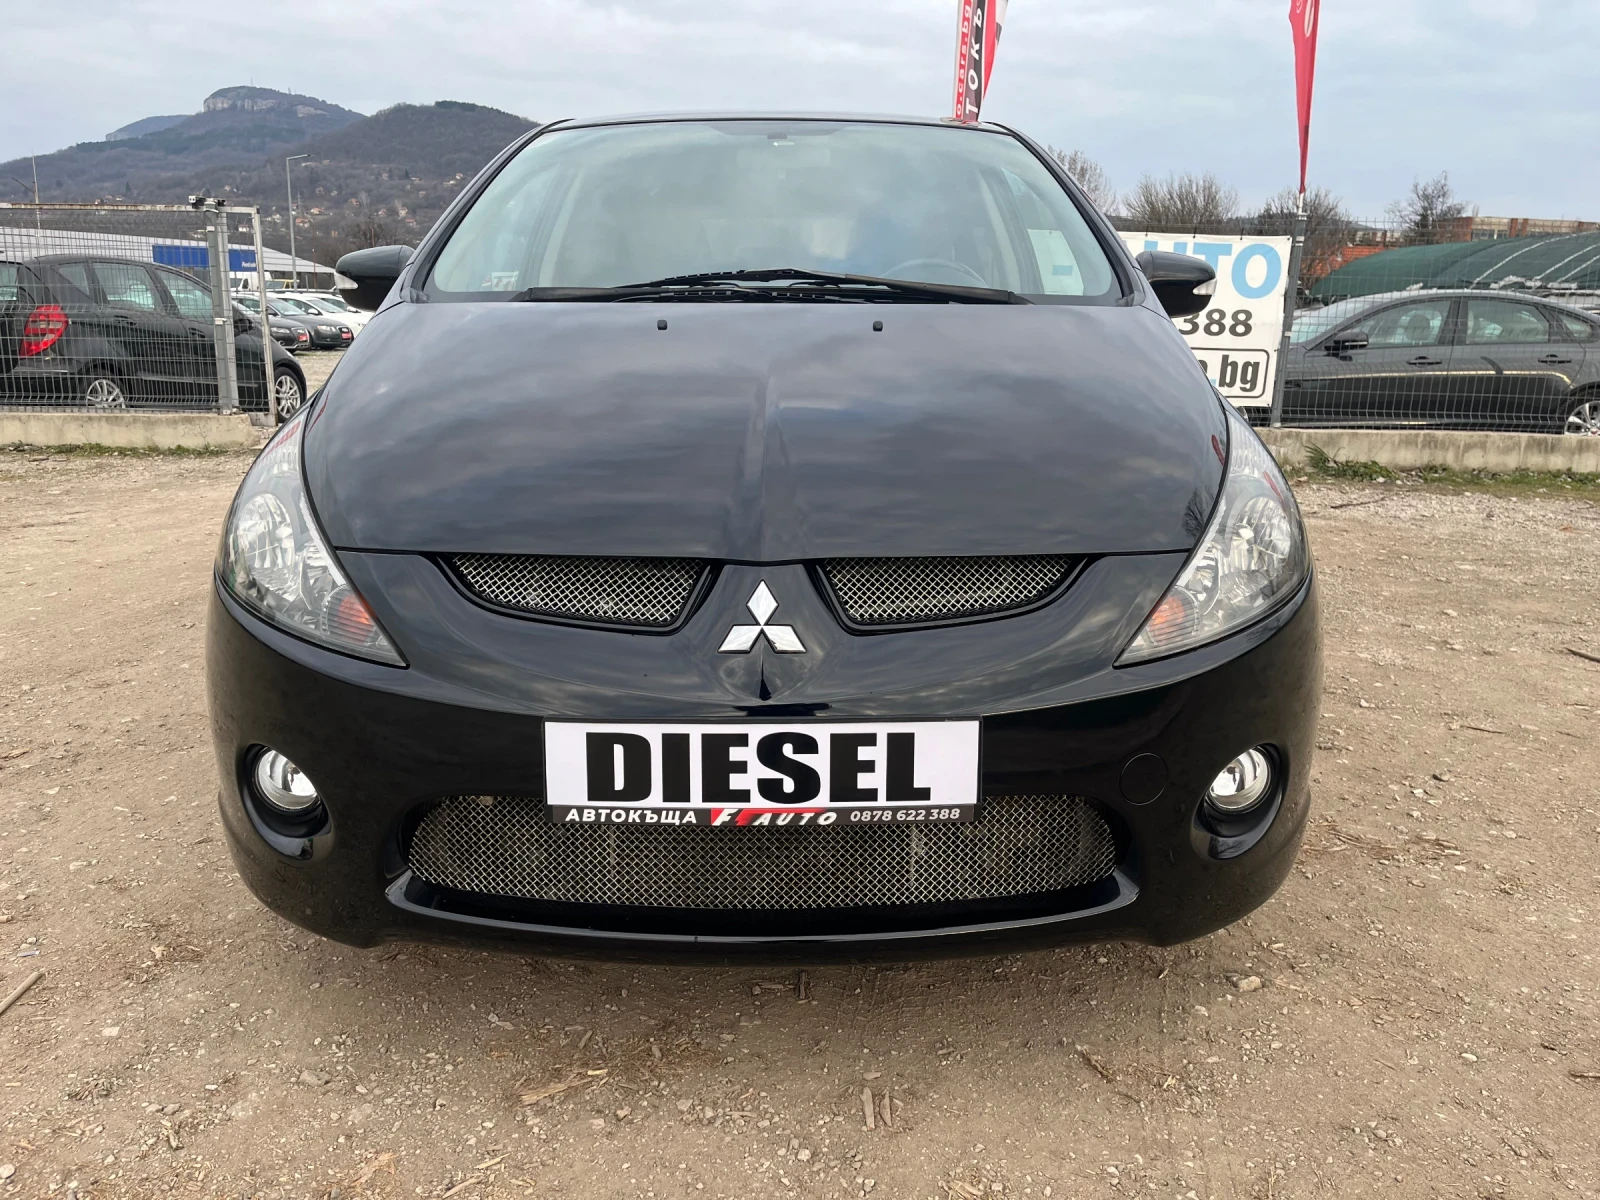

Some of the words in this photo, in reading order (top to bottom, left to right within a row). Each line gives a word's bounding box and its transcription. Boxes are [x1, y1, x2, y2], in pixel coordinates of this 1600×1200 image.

[585, 731, 932, 805] DIESEL
[564, 808, 698, 826] АВТОКЪЩА
[752, 811, 838, 827] AUTO
[850, 810, 893, 822] 0878
[896, 809, 926, 821] 622
[928, 807, 961, 820] 388
